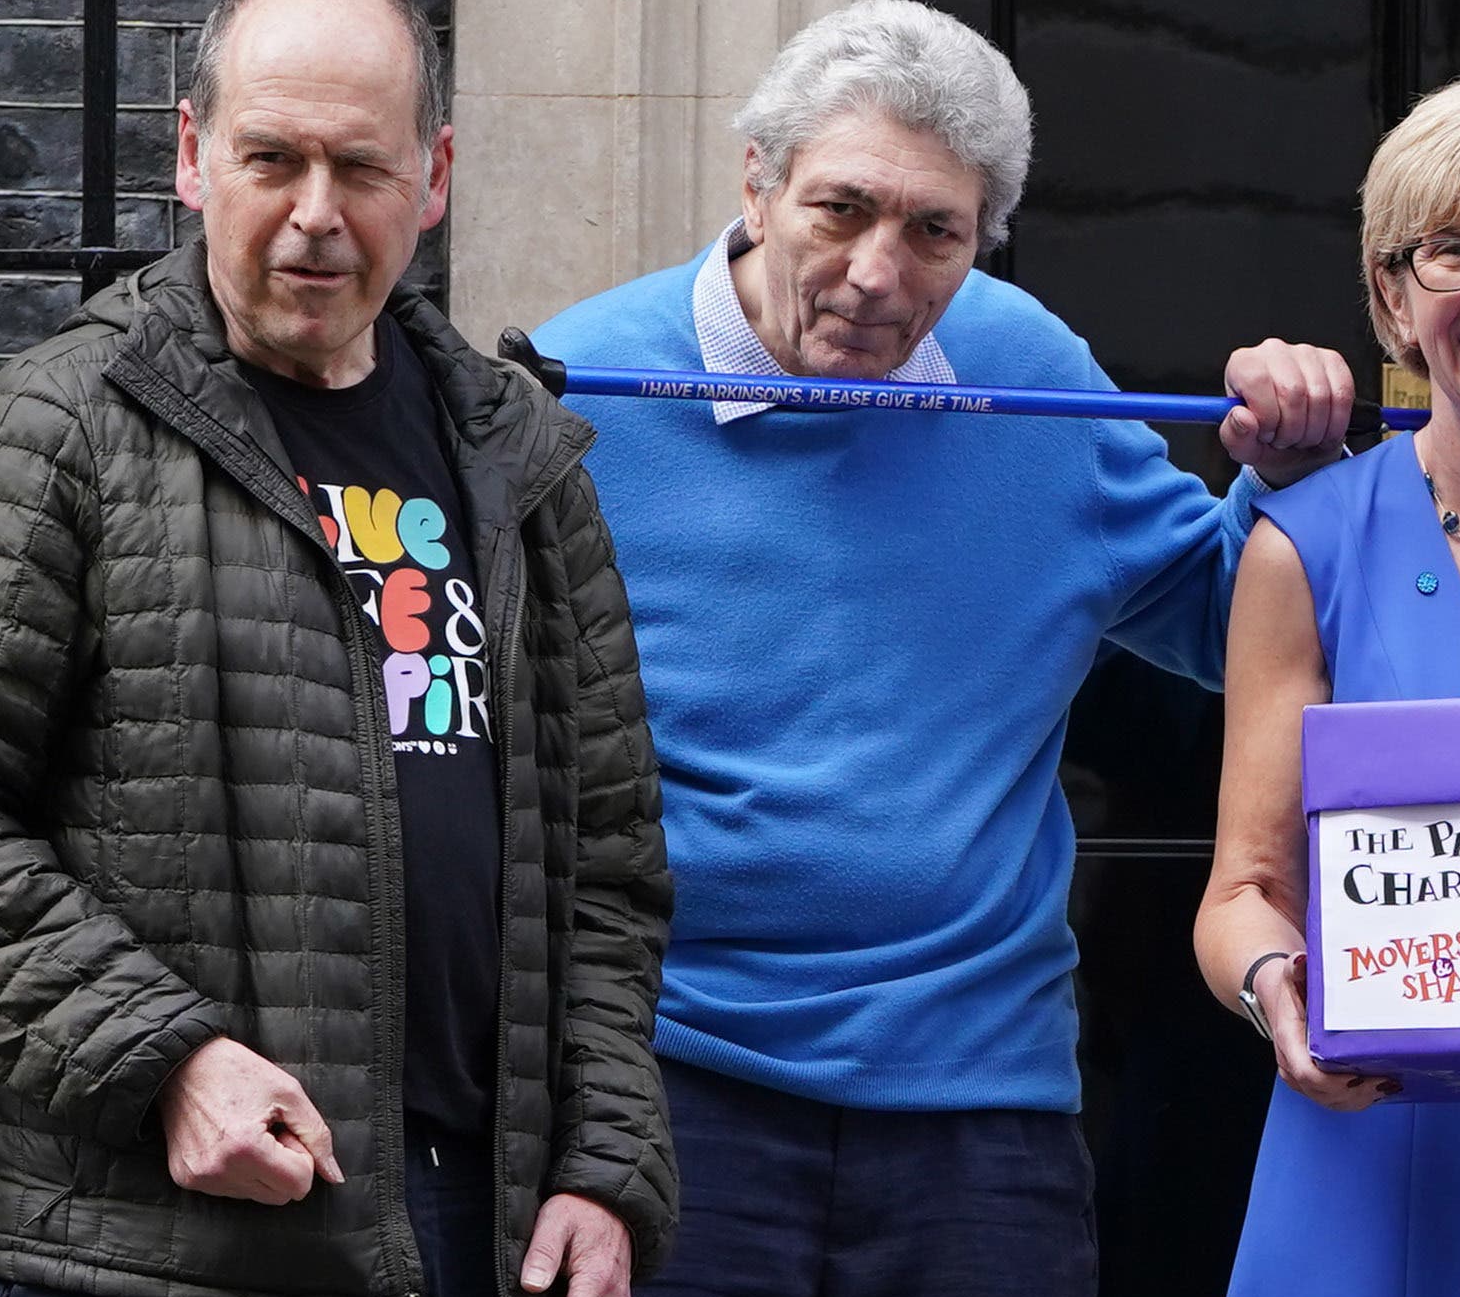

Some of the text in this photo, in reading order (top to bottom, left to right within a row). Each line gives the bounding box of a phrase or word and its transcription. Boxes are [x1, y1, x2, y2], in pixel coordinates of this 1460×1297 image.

[640, 381, 647, 396] I
[648, 381, 694, 398] HAVE
[809, 388, 873, 406] PLEASE
[876, 391, 916, 409] GIVE
[919, 394, 946, 410] ME
[951, 396, 994, 413] TIME.
[1345, 827, 1414, 855] THE
